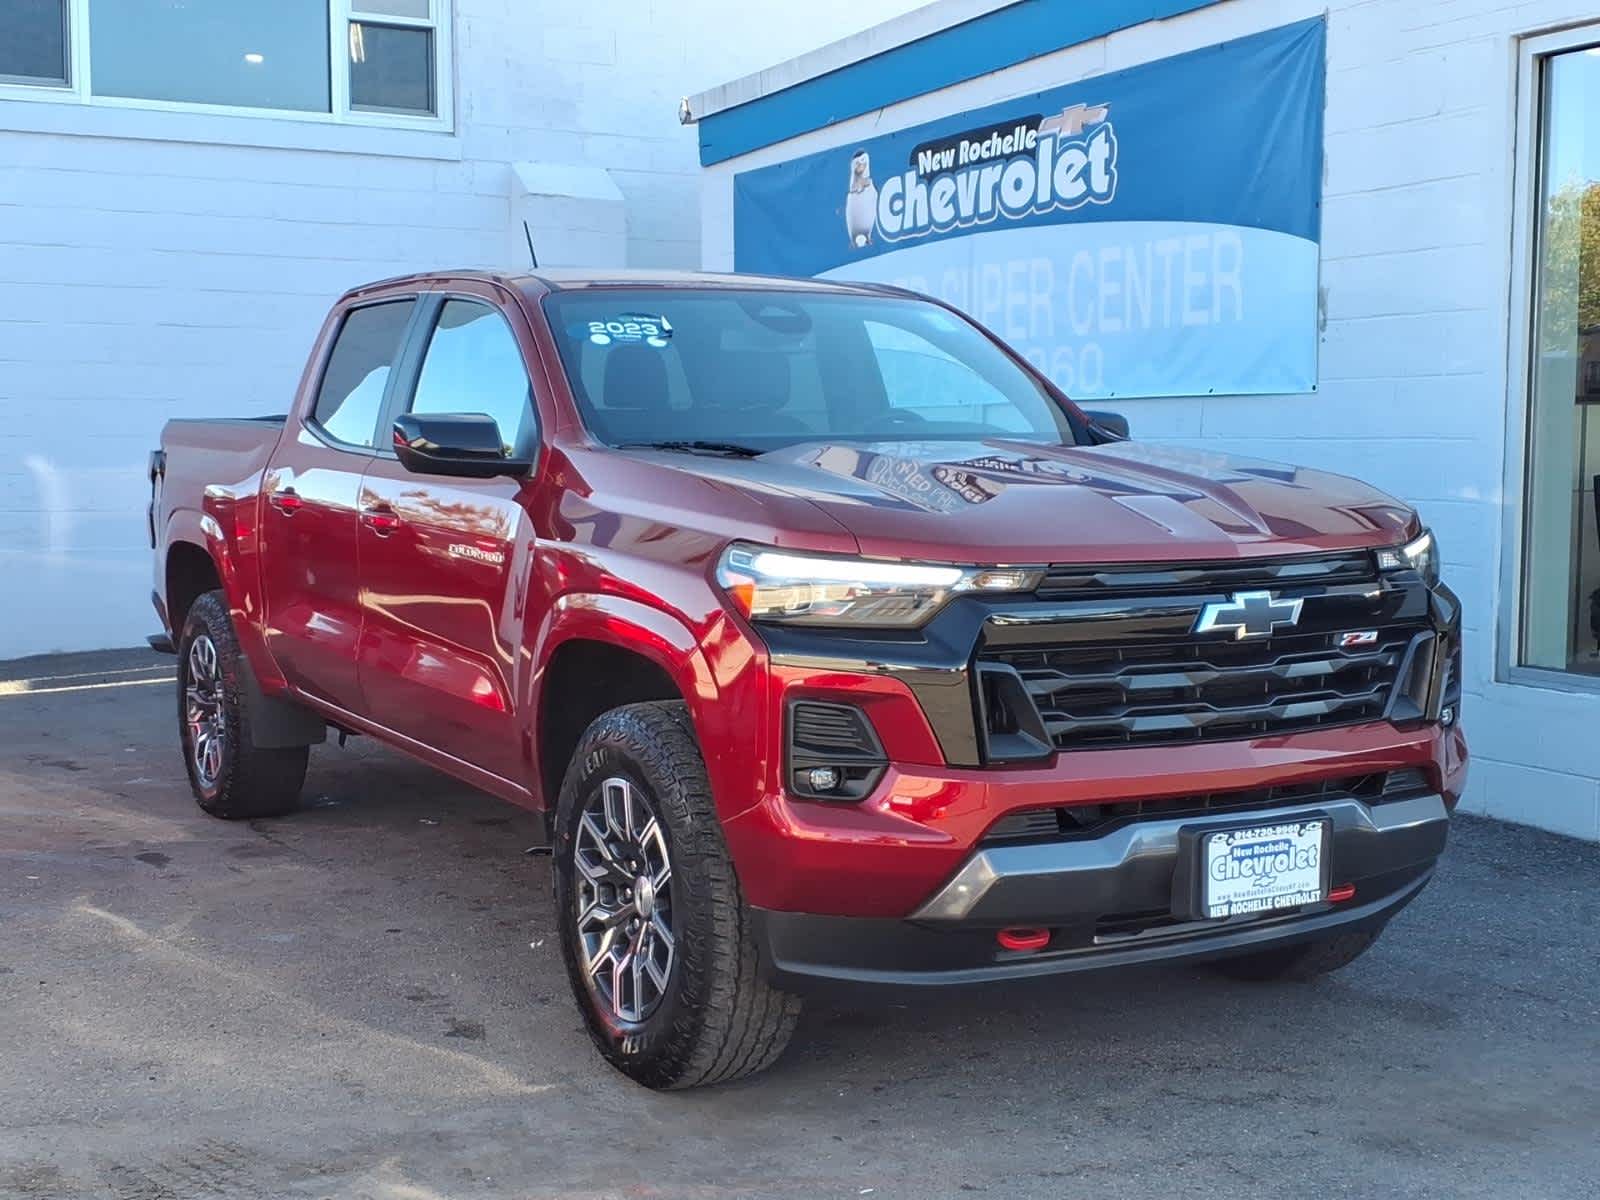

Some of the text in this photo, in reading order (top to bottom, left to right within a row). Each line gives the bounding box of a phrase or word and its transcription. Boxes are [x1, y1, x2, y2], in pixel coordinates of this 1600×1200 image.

[918, 125, 1037, 176] New Rochelle
[878, 131, 1110, 233] Chevrolet
[942, 231, 1244, 340] SUPER CENTER
[588, 322, 658, 336] 2023
[1211, 845, 1318, 881] Chevrolet
[1233, 841, 1290, 858] New Rochelle
[1210, 890, 1321, 918] NEW ROCHELLE CHEVROLET
